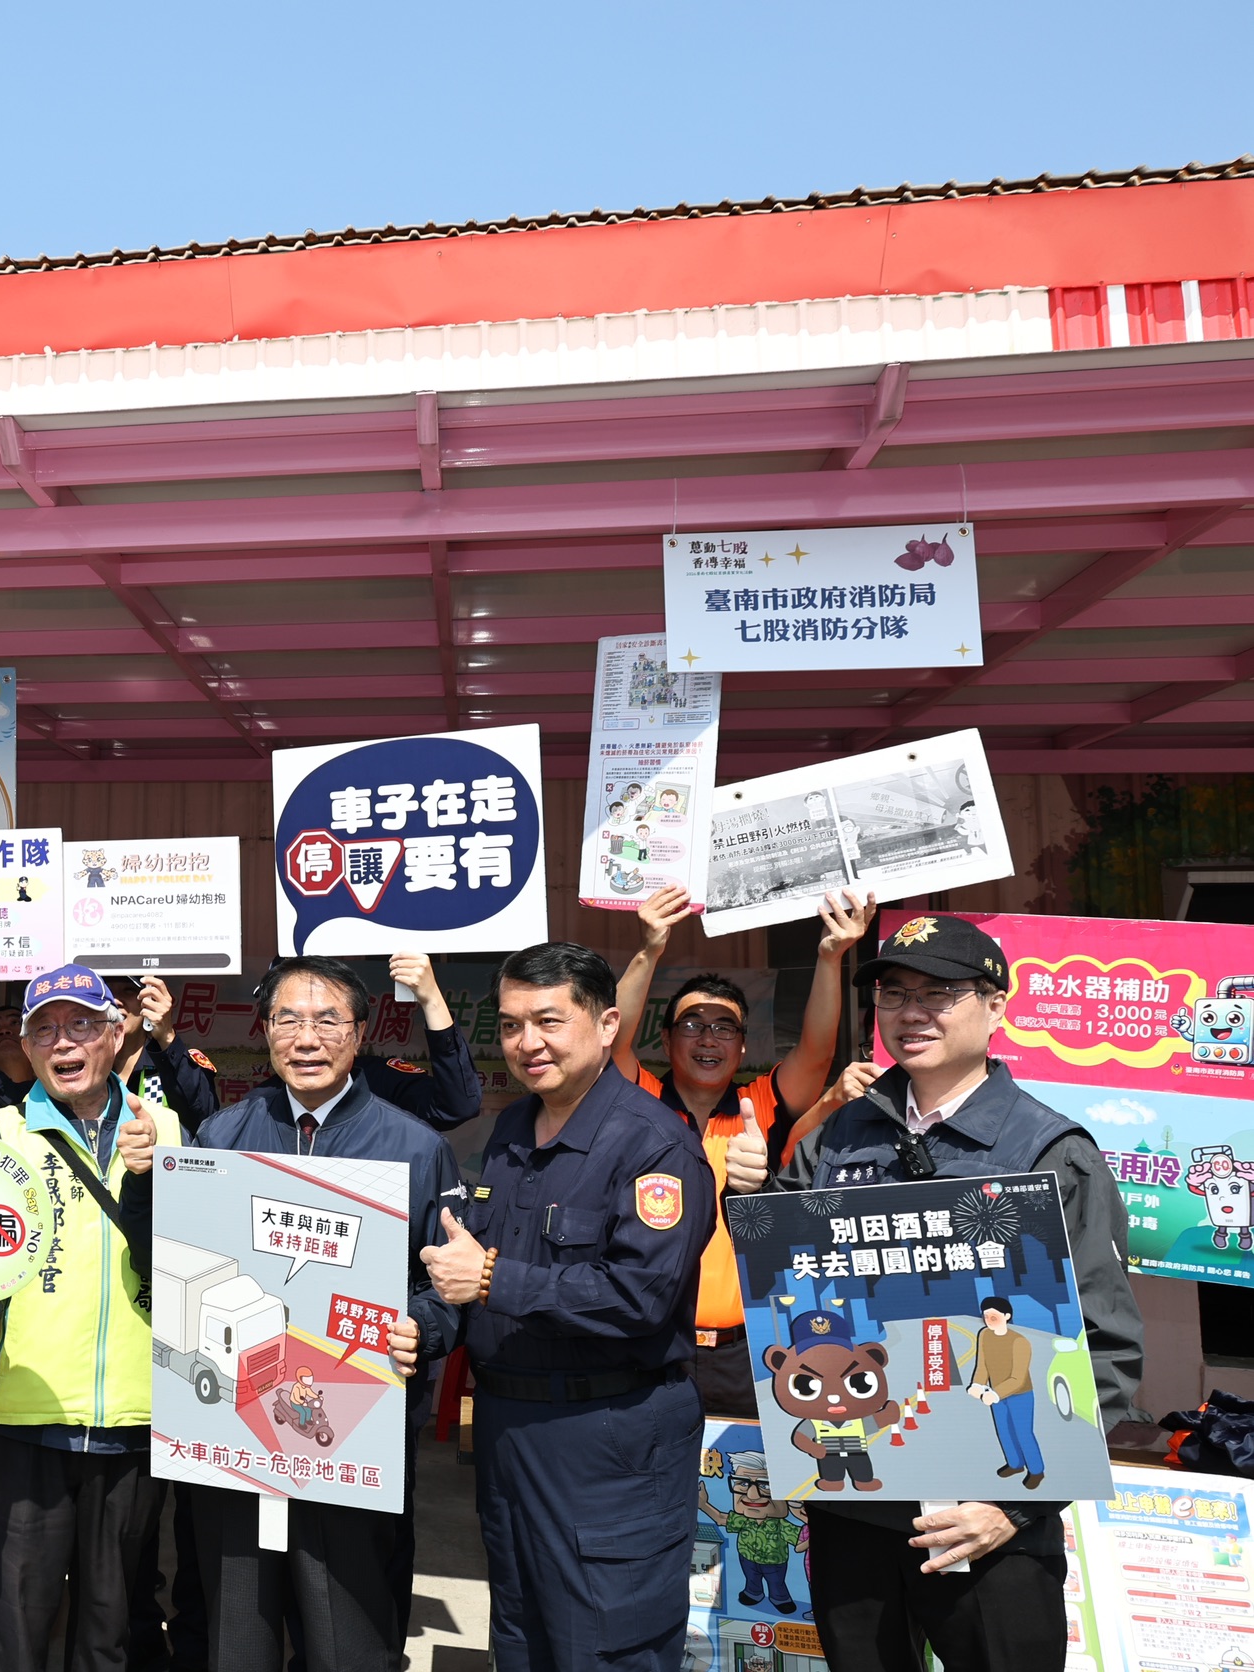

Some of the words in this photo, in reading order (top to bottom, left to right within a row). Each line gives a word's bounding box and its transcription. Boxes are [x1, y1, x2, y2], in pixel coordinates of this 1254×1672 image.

[692, 557, 746, 570] 香傳幸福
[704, 582, 936, 612] 臺南市政府消防局
[734, 615, 909, 643] 七股消防分隊
[330, 774, 517, 834] 車子在走
[713, 819, 812, 851] 禁止田野引火燃燒
[121, 852, 210, 873] 婦幼抱抱
[120, 875, 154, 885] HAPPY
[156, 874, 191, 884] POLICE
[193, 873, 213, 883] DAY
[110, 895, 174, 906] NPACareU
[176, 893, 227, 905] 婦幼抱抱
[3, 936, 31, 949] 不信
[0, 949, 34, 958] 可疑資訊
[142, 958, 160, 967] 訂閱
[0, 964, 34, 975] 關心您
[34, 974, 93, 997] 路老師
[1028, 973, 1170, 1003] 熱水器補助
[1036, 1003, 1082, 1015] 每戶最高
[1014, 1016, 1081, 1031] 低收入戶最高
[1185, 1066, 1245, 1078] 臺南市政府消防局
[178, 1158, 216, 1167] 中華民國交通部
[835, 1166, 875, 1184] 臺南市
[1004, 1183, 1050, 1194] 交通部道安會
[23, 1188, 39, 1215] Say
[1121, 1192, 1161, 1208] 戶外
[261, 1207, 350, 1237] 大車與前車
[829, 1210, 954, 1245] 別因酒駕
[268, 1230, 338, 1259] 保持距離
[792, 1240, 1006, 1281] 失去團圓的機會
[1141, 1258, 1205, 1273] 臺南市政府消防局
[1207, 1266, 1232, 1276] 關心您
[334, 1299, 393, 1326] 視野死角
[336, 1318, 381, 1346] 危險
[927, 1324, 944, 1387] 停車受檢
[169, 1439, 382, 1488] 大車前方=危險地雷區
[758, 1632, 767, 1644] 2
